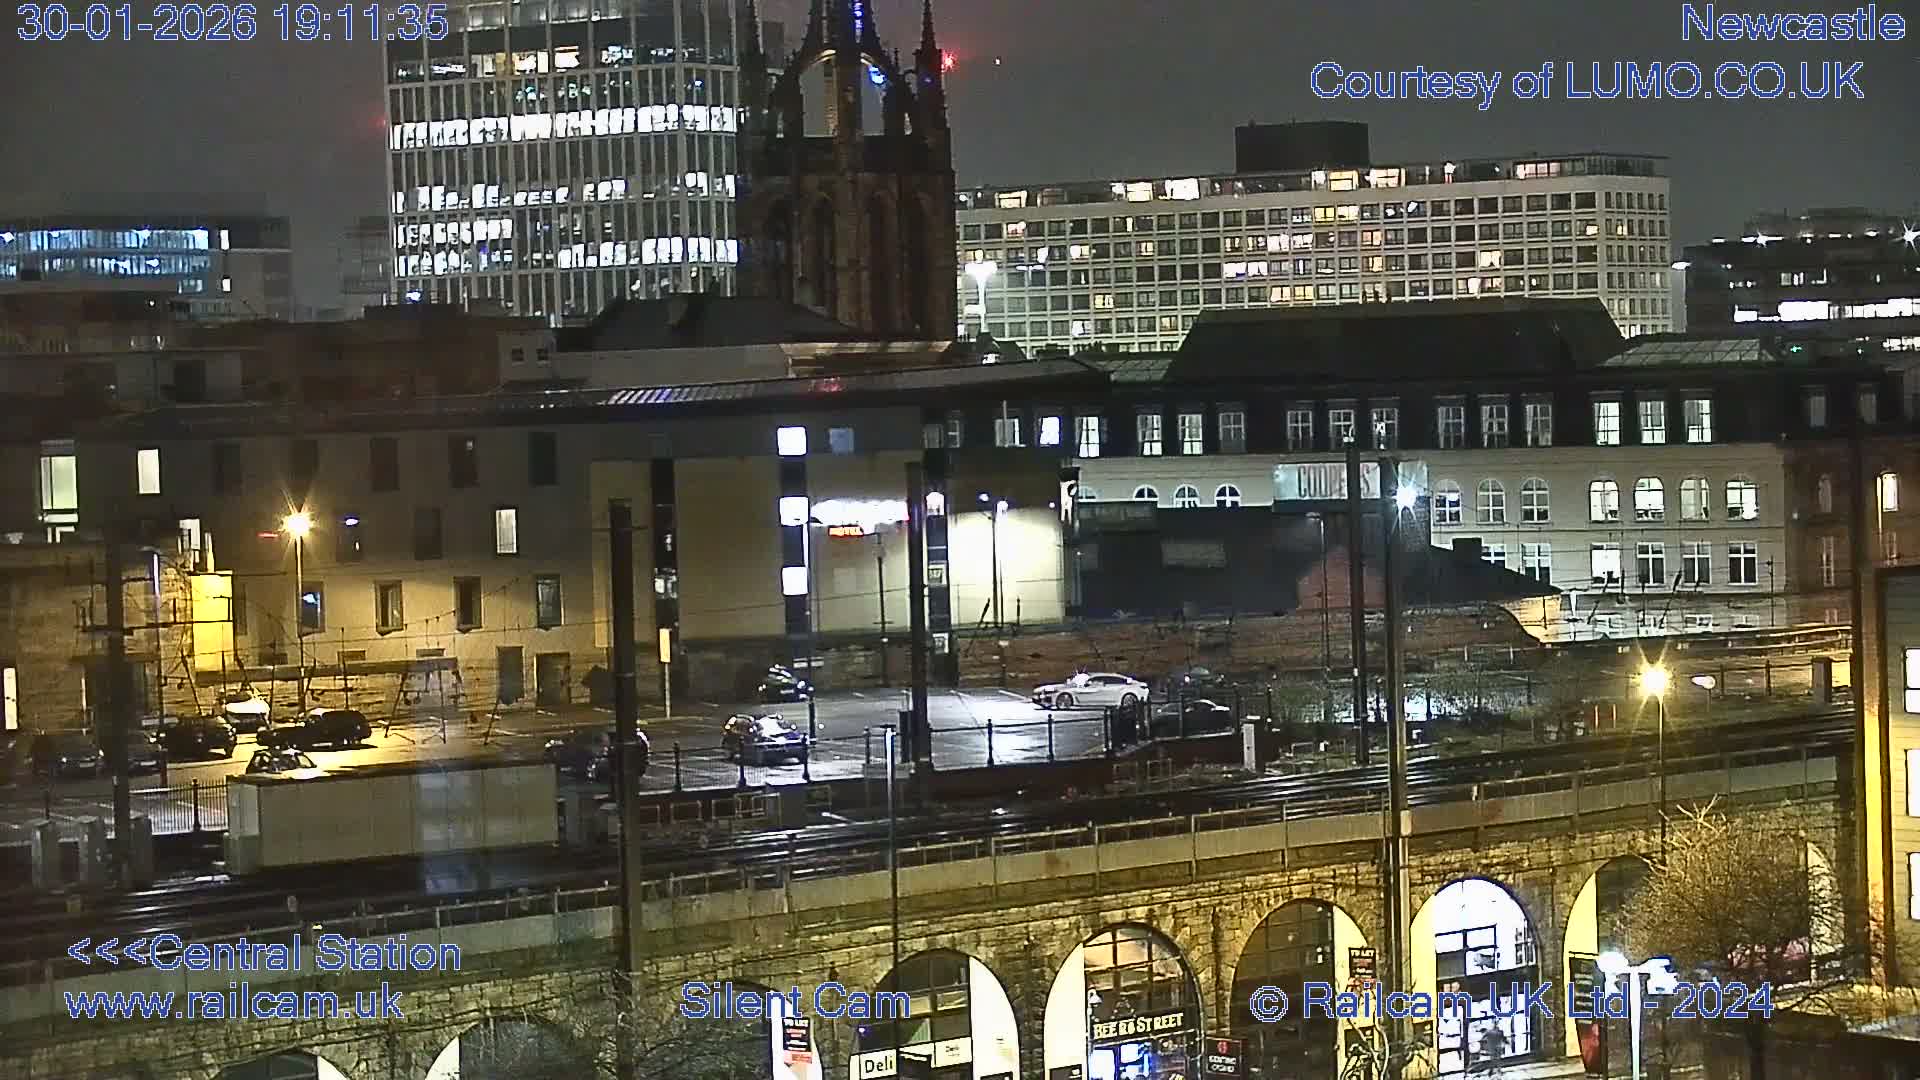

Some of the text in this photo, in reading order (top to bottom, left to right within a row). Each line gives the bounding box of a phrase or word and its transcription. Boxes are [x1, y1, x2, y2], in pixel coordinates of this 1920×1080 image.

[1297, 464, 1370, 499] COOPES
[1136, 1012, 1185, 1032] STREET
[864, 1055, 894, 1074] Deli
